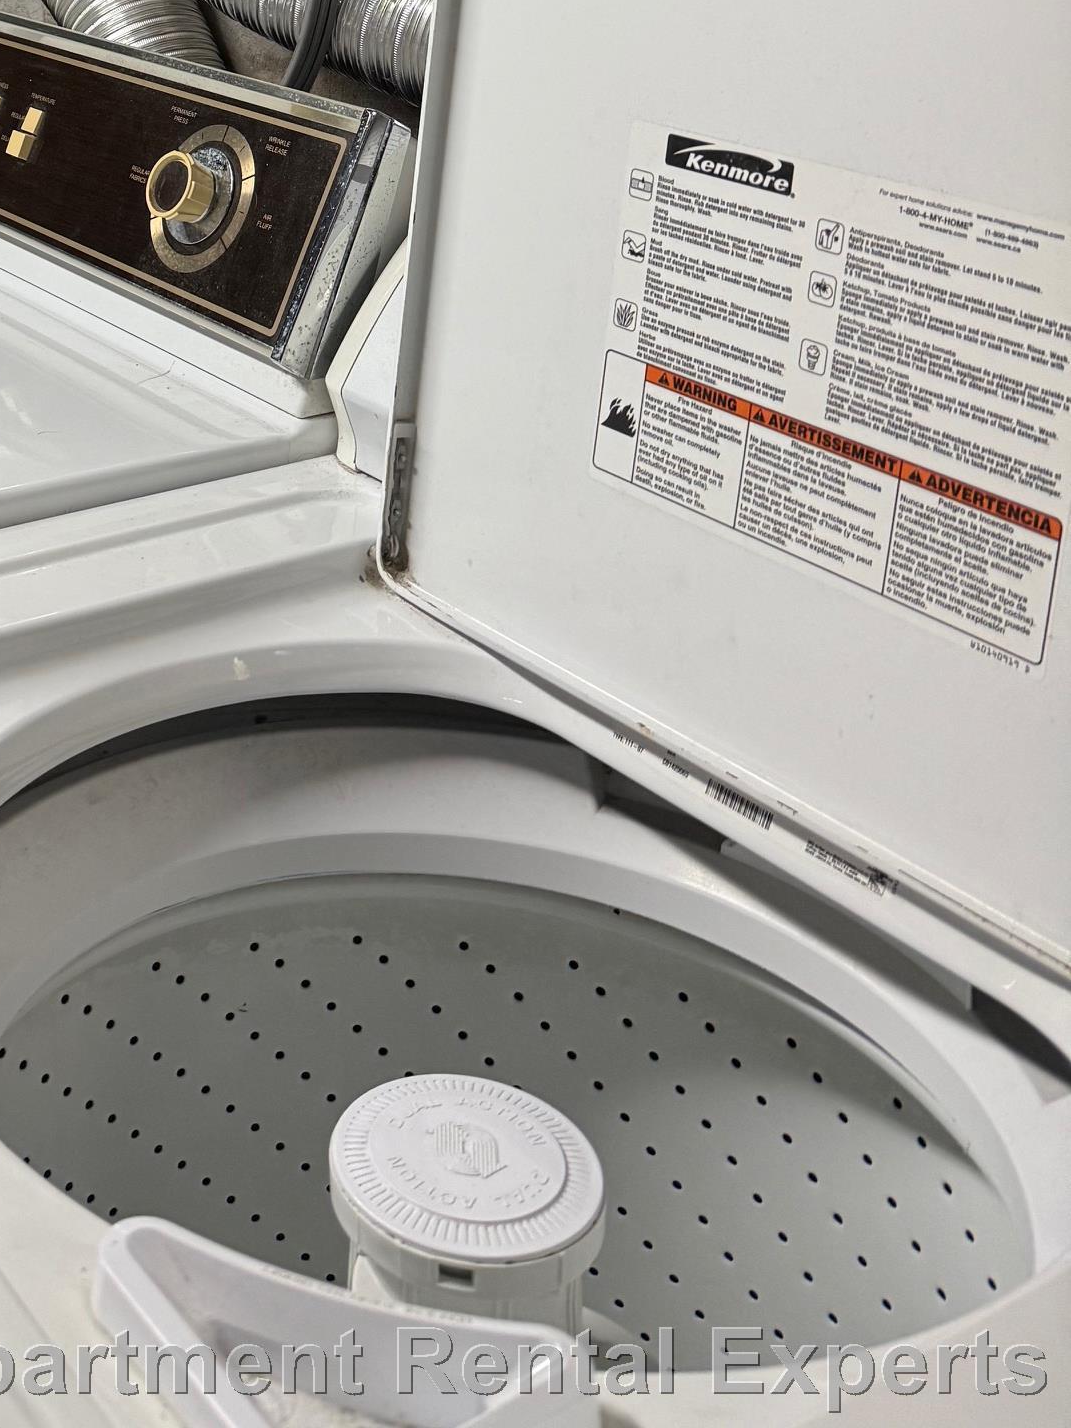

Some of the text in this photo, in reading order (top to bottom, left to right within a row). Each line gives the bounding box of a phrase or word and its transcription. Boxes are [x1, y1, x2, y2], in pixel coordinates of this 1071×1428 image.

[170, 105, 197, 119] PERMANENT
[173, 116, 189, 125] PRESS
[265, 144, 289, 156] RELEASE
[268, 135, 292, 147] WRINKLE
[657, 174, 674, 184] Blood
[685, 152, 789, 192] Kenmore
[255, 220, 273, 231] FLUFF
[262, 213, 272, 221] AIR
[650, 237, 662, 246] Mud
[641, 306, 658, 317] Grass
[873, 289, 898, 303] Tomato
[899, 297, 930, 313] Products
[874, 362, 885, 372] Ice
[886, 366, 909, 380] Cream
[672, 375, 737, 411] WARNING
[677, 395, 712, 415] Fire Hazard
[644, 400, 742, 445] that are dampened with gasoline
[645, 392, 741, 436] Never place items in the washer
[651, 412, 667, 423] other
[668, 418, 699, 436] flammable
[700, 431, 719, 444] fluids.
[640, 428, 673, 446] remove oil.
[641, 420, 720, 459] No washer can completely
[767, 413, 897, 472] AVERTISSEMENT
[790, 439, 814, 455] Risque
[637, 454, 708, 490] (including cooking oils).
[638, 447, 722, 488] ever had any type of oil on it
[639, 438, 723, 480] Do not dry anything that has
[747, 450, 791, 474] inflammables
[792, 469, 809, 481] dans
[810, 475, 817, 484] la
[749, 434, 759, 443] Ne
[759, 438, 781, 452] jamais
[782, 448, 804, 462] mettre
[805, 457, 818, 467] des
[819, 463, 845, 478] articles
[782, 457, 792, 465] ou
[821, 471, 845, 487] fluides
[634, 474, 652, 487] death,
[653, 483, 684, 502] explosion,
[693, 499, 705, 510] fire.
[635, 465, 653, 480] Doing
[663, 478, 674, 488] can
[675, 484, 693, 496] result
[693, 491, 700, 499] in
[899, 493, 924, 509] Nunca
[925, 505, 956, 522] coloque
[957, 518, 968, 527] en
[969, 521, 977, 531] la
[979, 524, 1013, 545] lavadora
[925, 473, 1051, 534] ADVERTENCIA
[937, 497, 1014, 533] Peligro de incendio
[898, 503, 913, 514] que
[936, 517, 989, 545] humedecidos
[991, 540, 1007, 552] con
[1008, 547, 1044, 567] gasolina
[387, 1096, 546, 1146] DUAL ACTION
